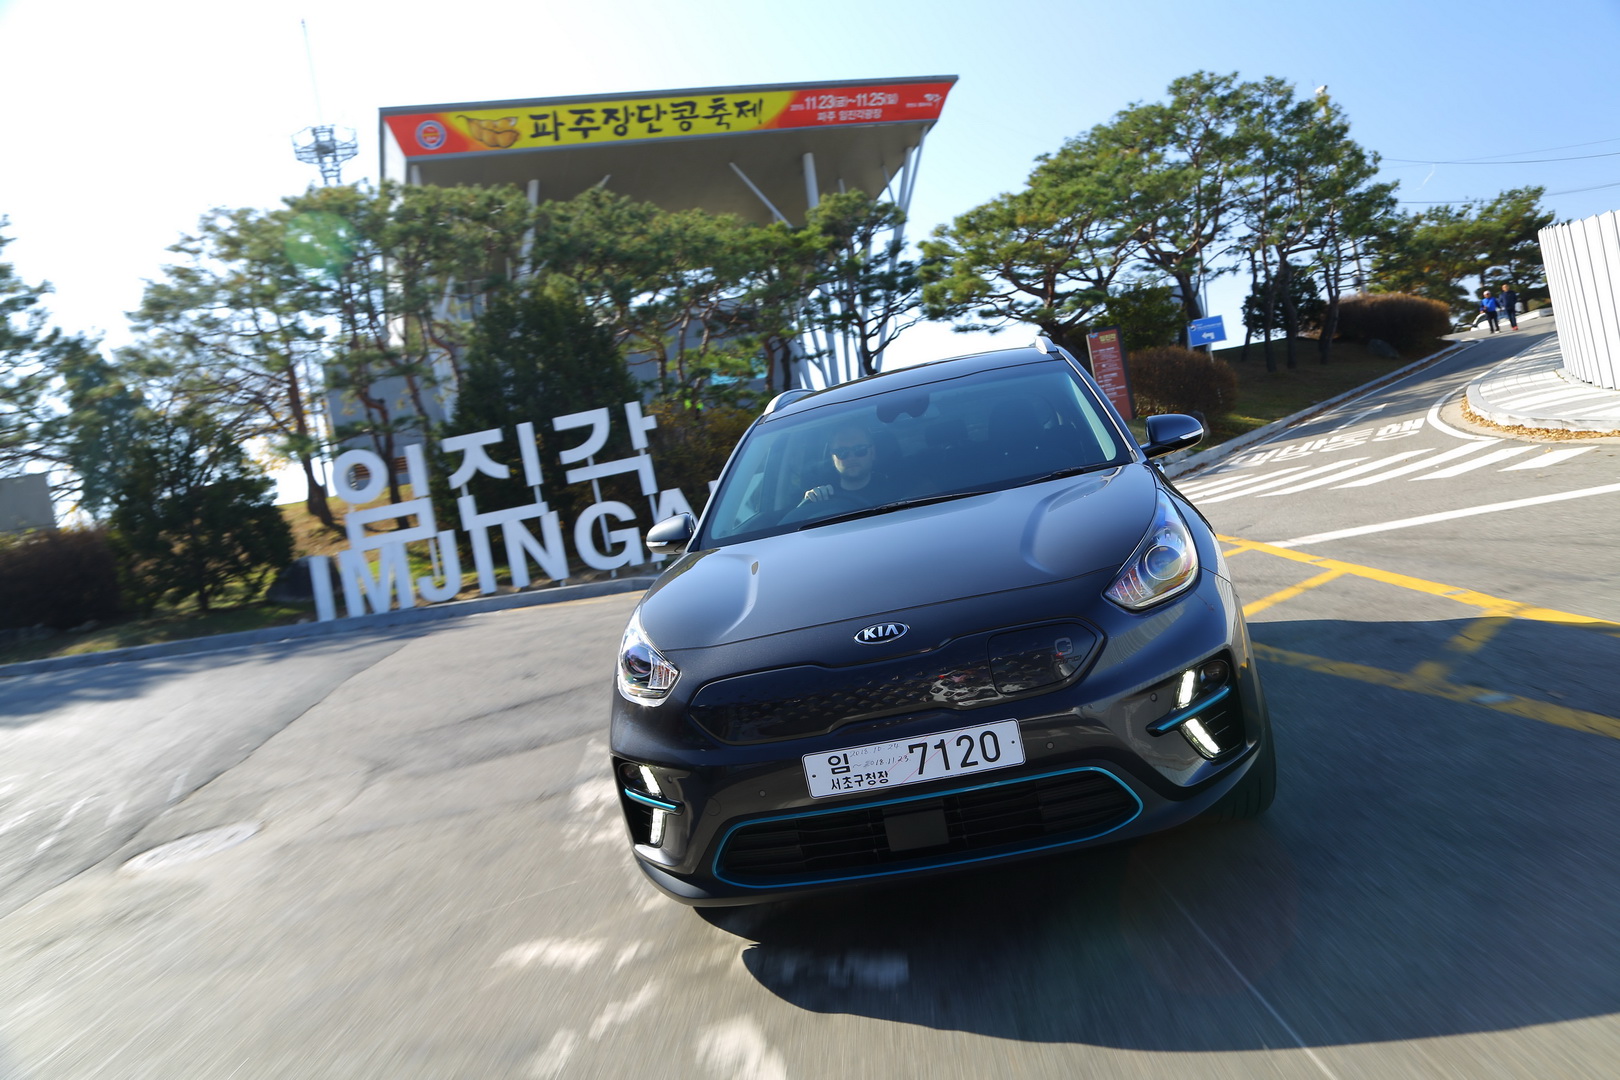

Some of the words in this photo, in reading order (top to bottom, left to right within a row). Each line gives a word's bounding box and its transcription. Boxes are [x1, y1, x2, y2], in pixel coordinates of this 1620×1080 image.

[529, 98, 763, 141] 파주장단콩축제
[332, 401, 658, 552] 임진각
[310, 480, 718, 623] IMJINGA
[863, 624, 899, 641] KIA
[827, 753, 851, 774] 임
[908, 730, 1002, 776] 7120
[831, 770, 889, 790] 서초구청장
